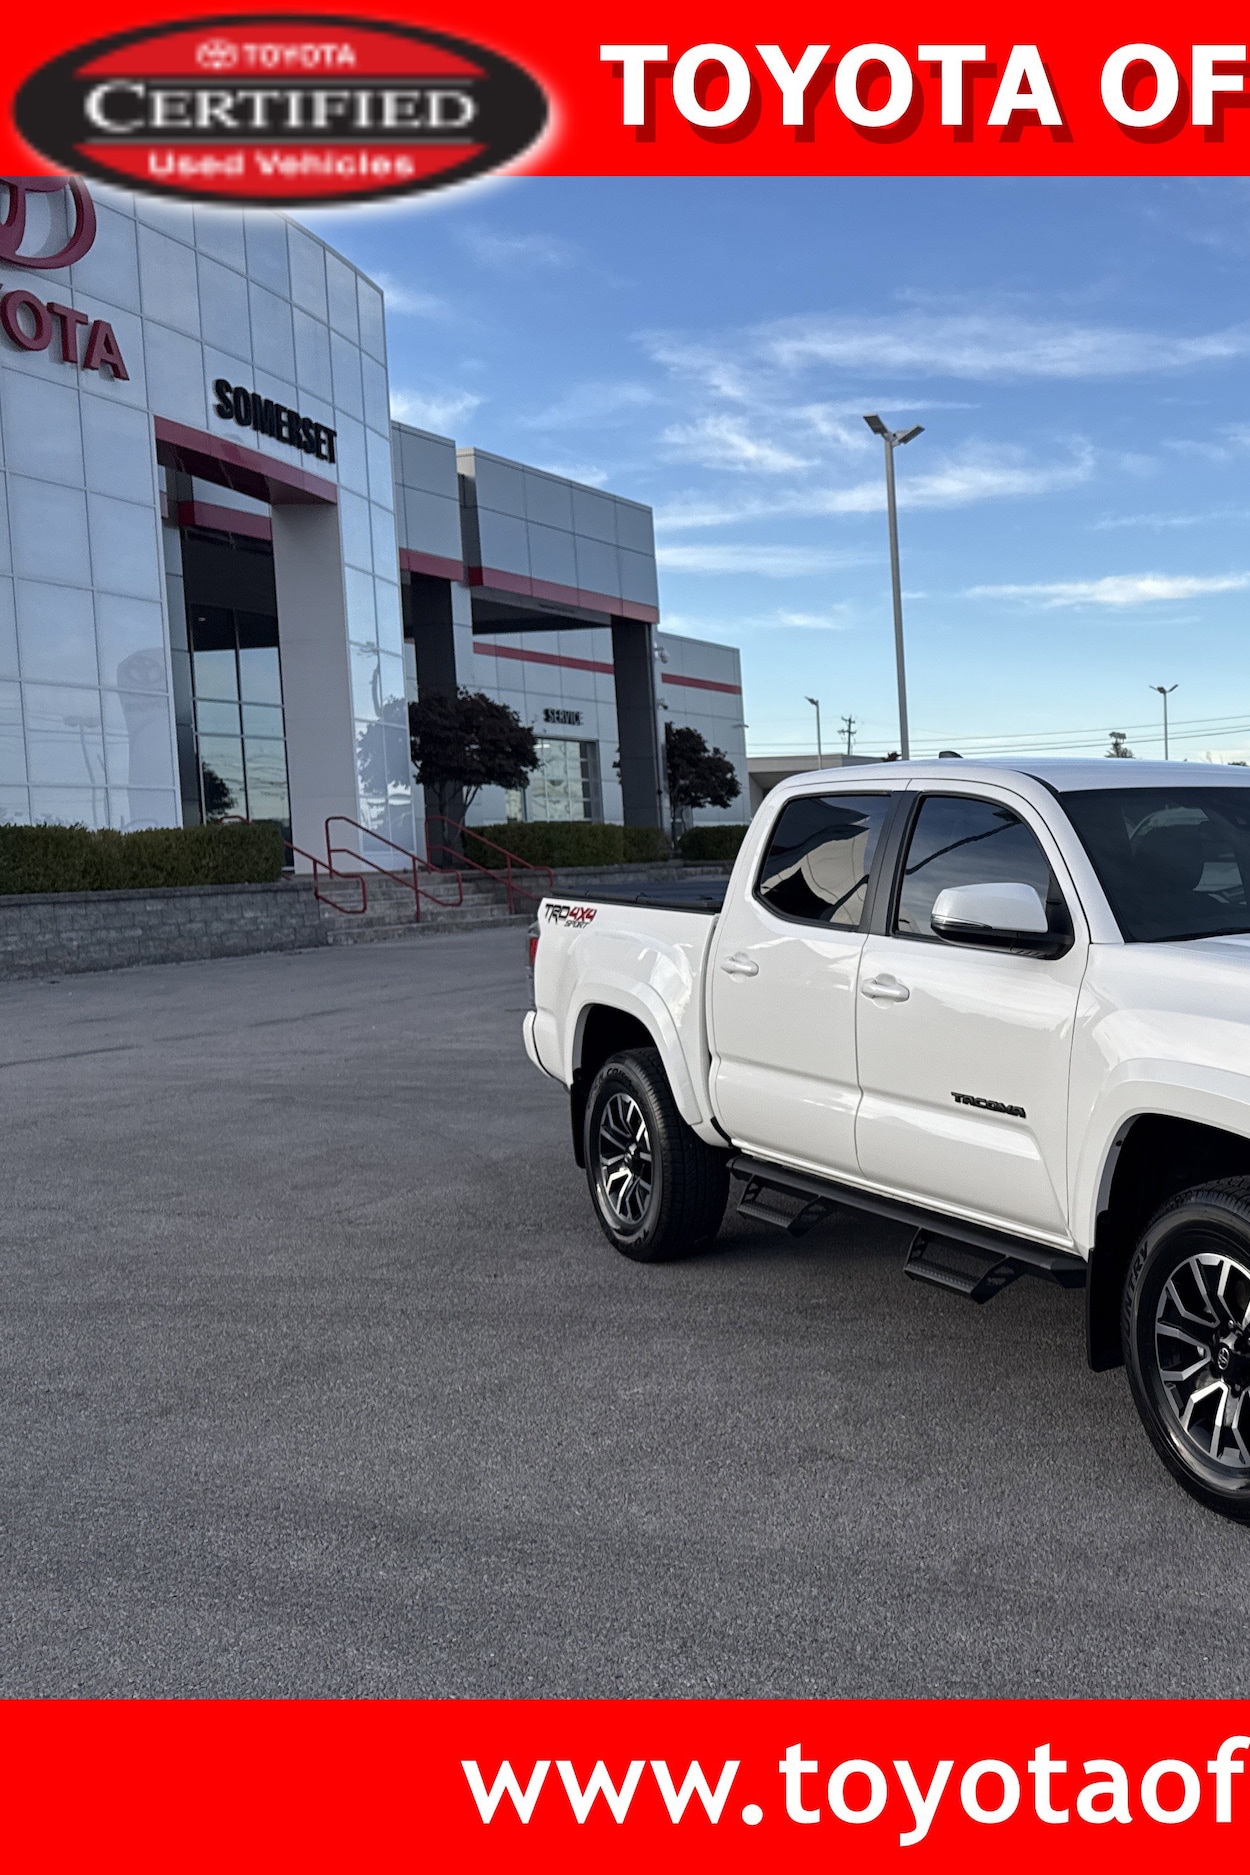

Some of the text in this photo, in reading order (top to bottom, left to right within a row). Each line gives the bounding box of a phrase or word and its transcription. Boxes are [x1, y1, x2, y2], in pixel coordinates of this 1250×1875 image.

[0, 284, 129, 381] OTA
[212, 378, 338, 465] SOMERSET
[543, 708, 584, 727] SERVICE
[564, 919, 591, 929] SPORT
[951, 1092, 1027, 1119] TACOMA
